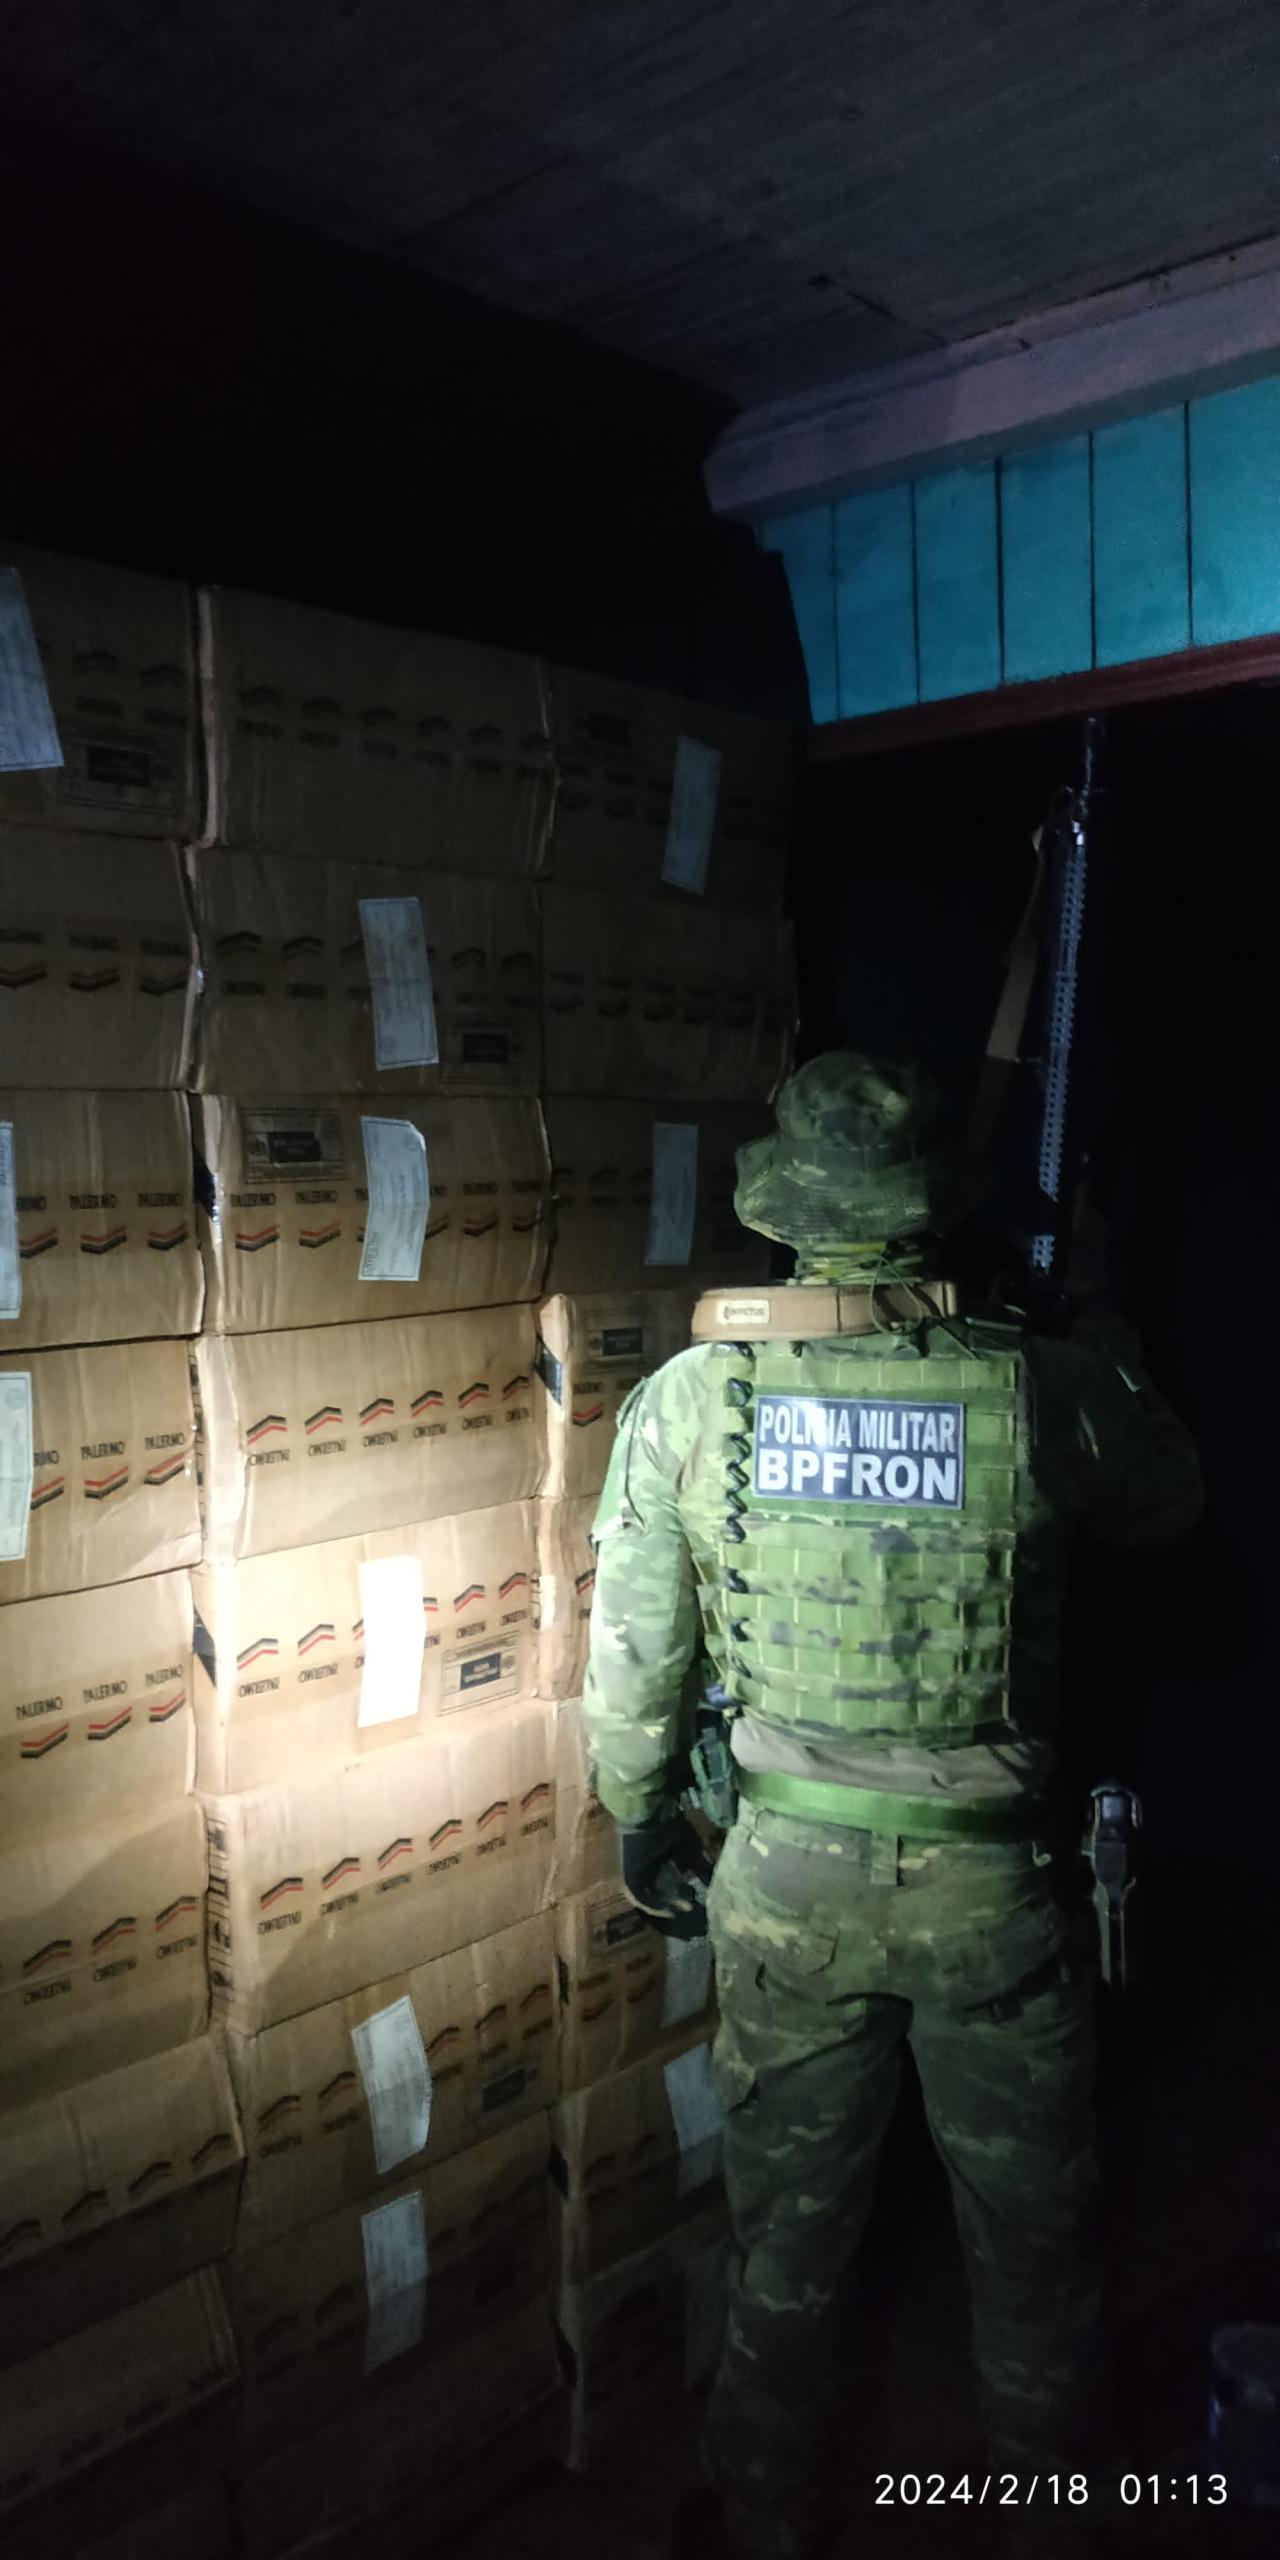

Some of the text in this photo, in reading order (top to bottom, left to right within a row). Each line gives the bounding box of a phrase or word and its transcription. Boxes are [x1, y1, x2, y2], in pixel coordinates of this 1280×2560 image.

[81, 1440, 126, 1460] PALERMO
[144, 1432, 185, 1451] PALERMO
[859, 1408, 956, 1454] MILITAR
[757, 1447, 958, 1501] BPFRON
[16, 1664, 184, 1721] PALERMO PALERMO PALERMO
[239, 1676, 280, 1698] PALERMO
